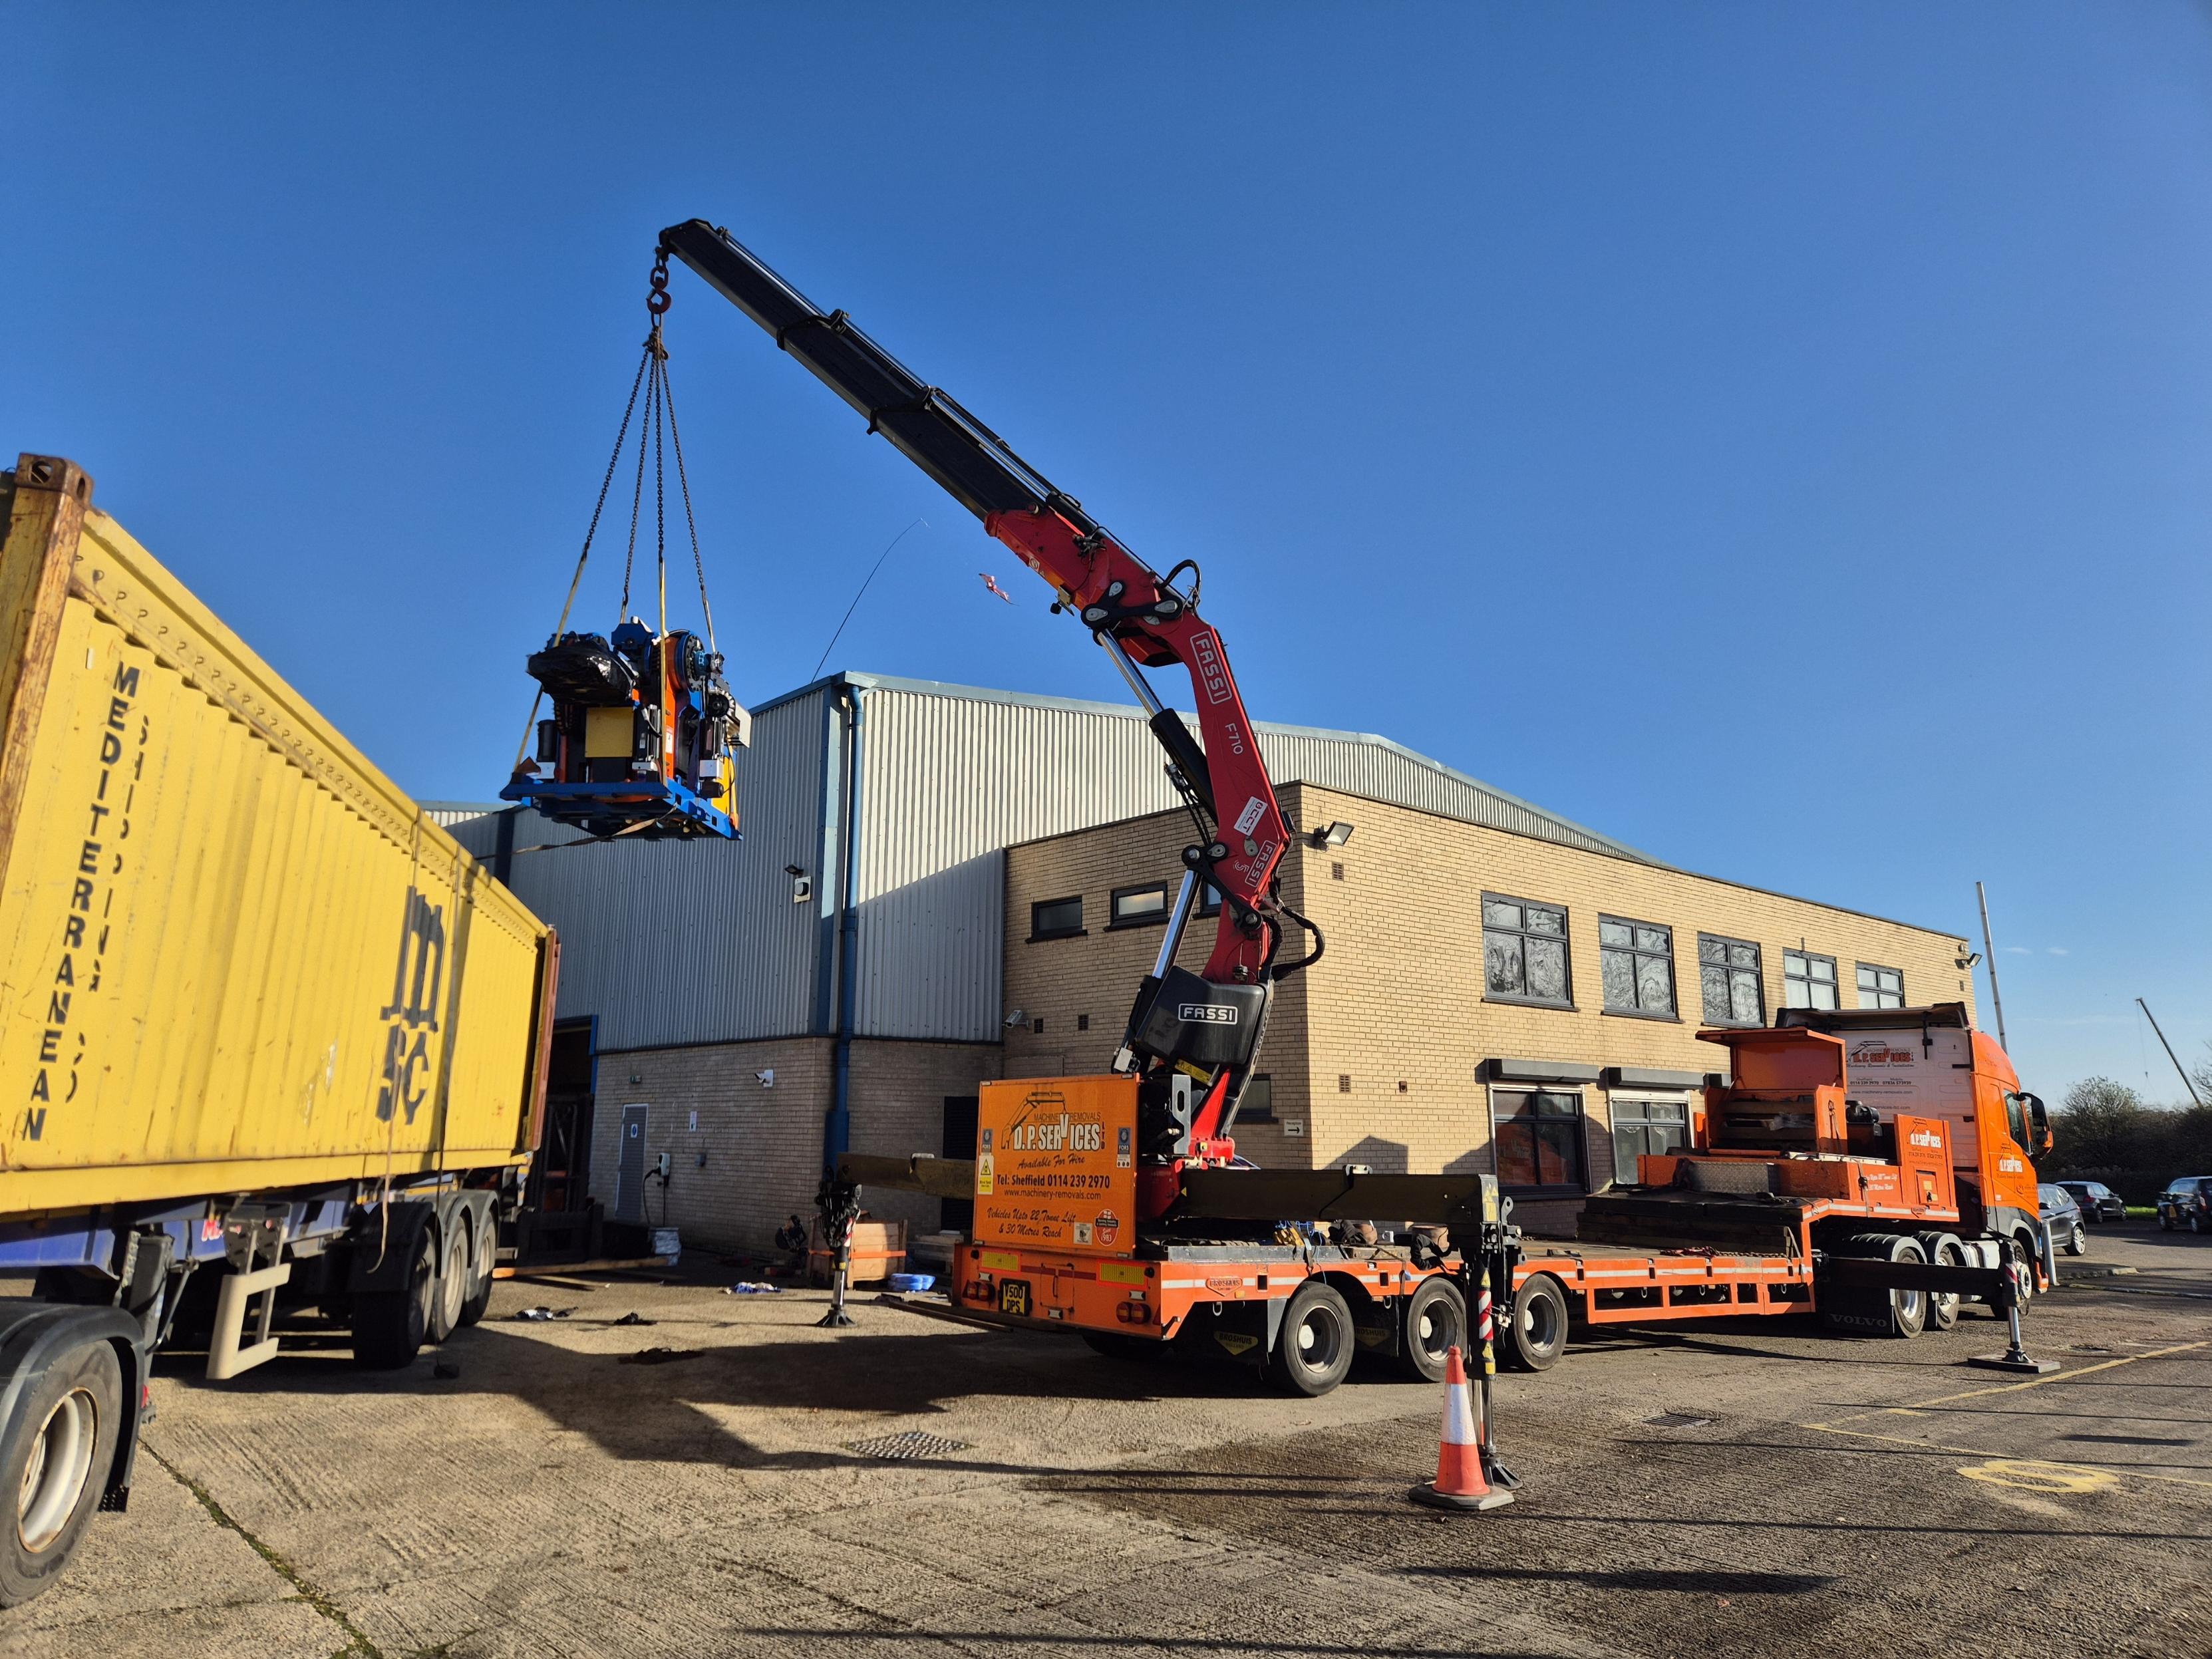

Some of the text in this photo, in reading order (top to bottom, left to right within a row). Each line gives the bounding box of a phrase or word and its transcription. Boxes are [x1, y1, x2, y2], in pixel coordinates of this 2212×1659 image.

[1196, 639, 1226, 697] FASSI
[1225, 722, 1243, 755] F710
[1249, 845, 1273, 883] FASSI
[23, 659, 140, 1141] MEDITERRANEAN
[1184, 1006, 1233, 1022] FASSI
[1070, 1112, 1101, 1121] REMOVALS
[1038, 1114, 1101, 1151] SERVICES
[1017, 1153, 1085, 1169] Available For Hire
[997, 1173, 1110, 1189] Tel: Sheffield 0114 239 2970
[1004, 1188, 1101, 1200] www.machinery-removals.com
[987, 1207, 1011, 1219] Vehicles
[1012, 1209, 1028, 1220] Upto
[1061, 1211, 1076, 1226] Lift
[999, 1223, 1062, 1238] & 30 Metres Reach
[1210, 1279, 1240, 1287] BROSHUIS
[1007, 1299, 1021, 1312] DPS
[1830, 1314, 1887, 1327] VOLVO
[1219, 1332, 1253, 1344] BROSHUIS
